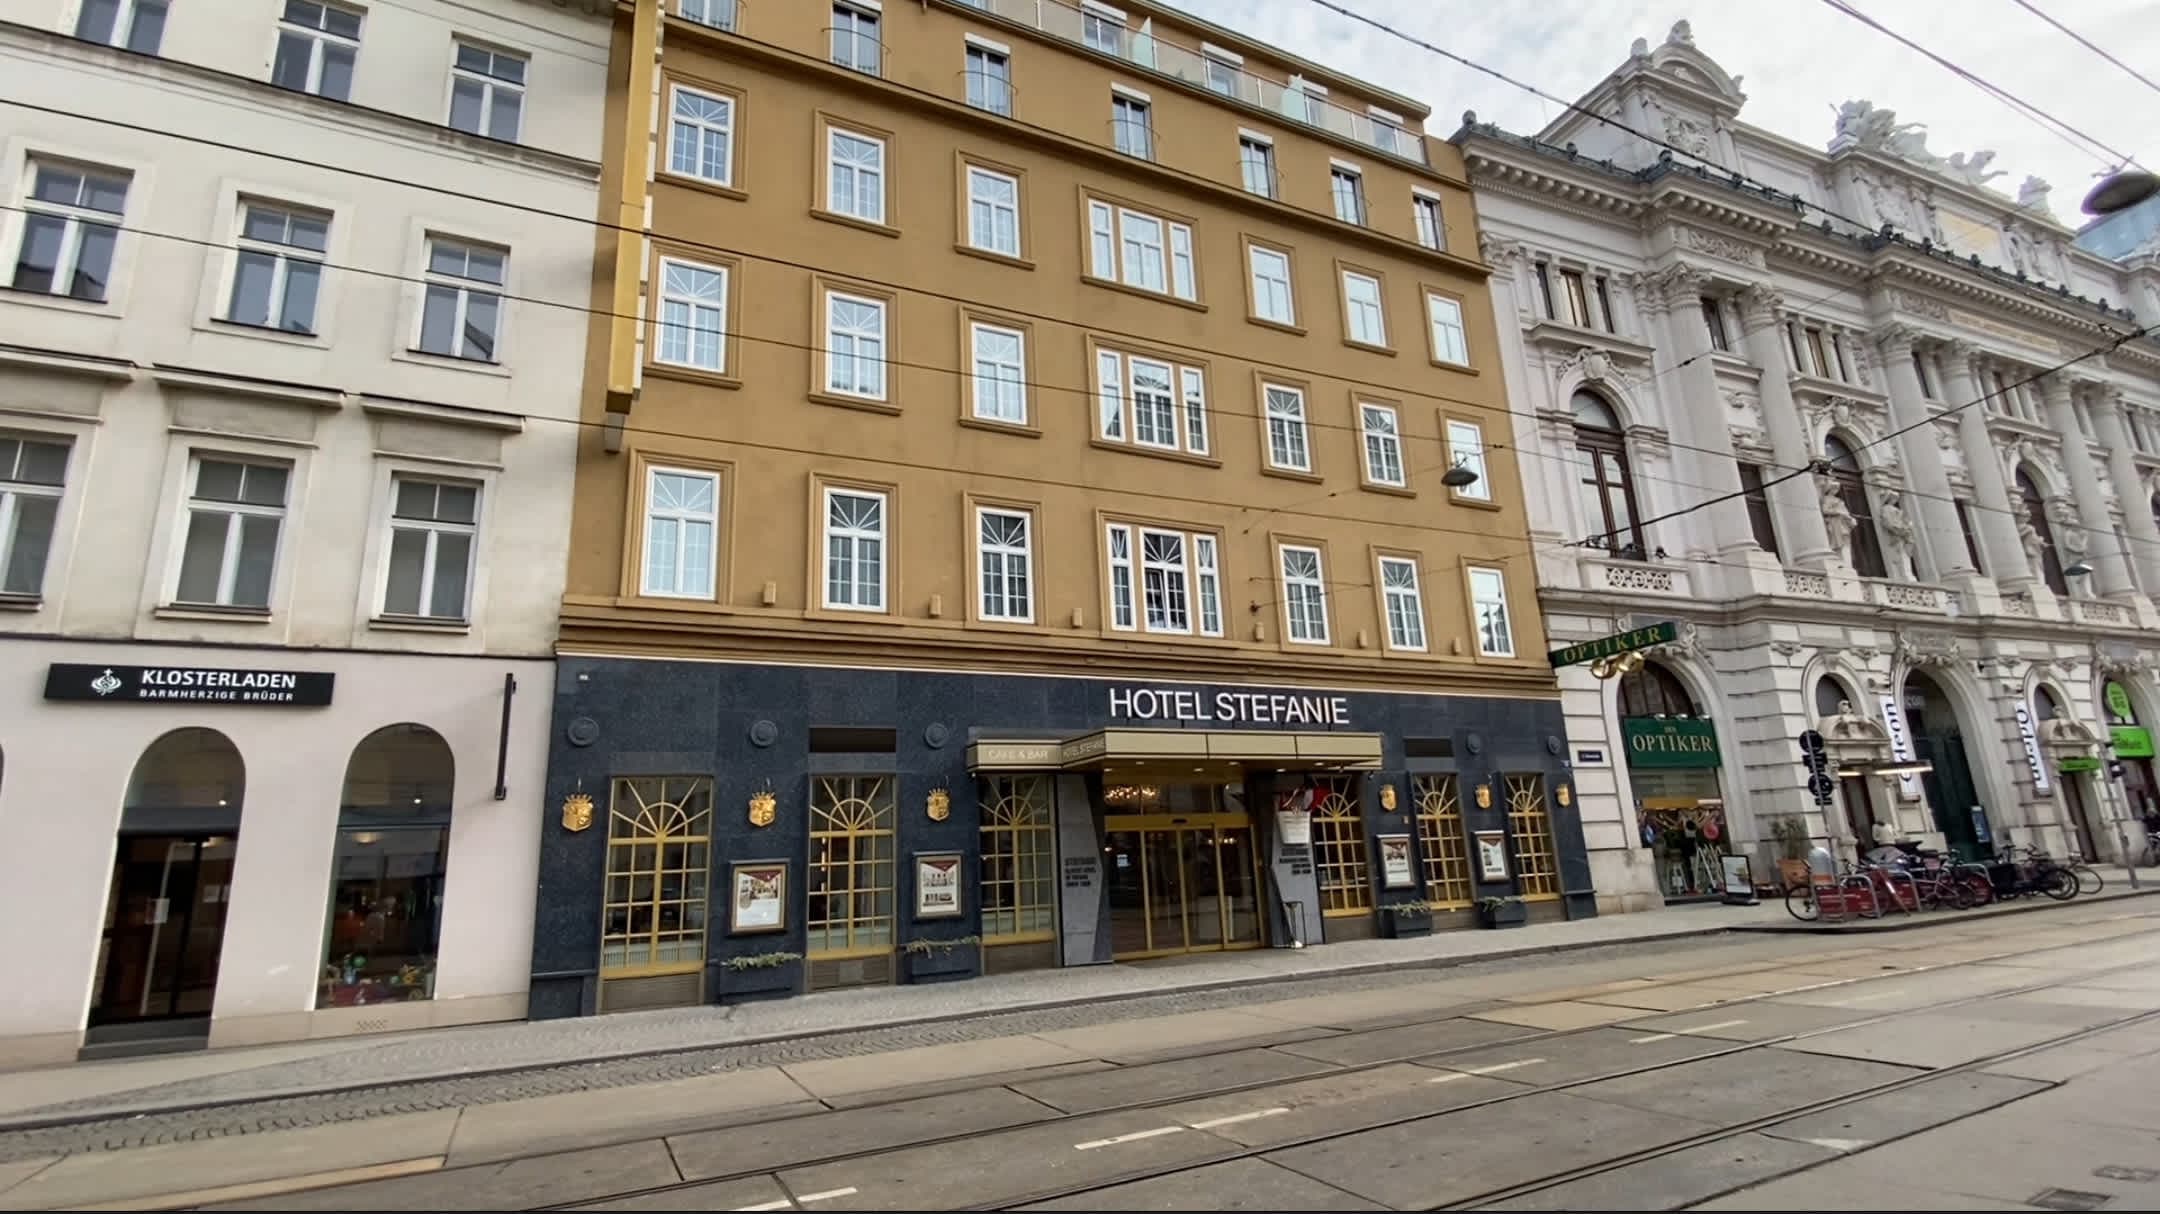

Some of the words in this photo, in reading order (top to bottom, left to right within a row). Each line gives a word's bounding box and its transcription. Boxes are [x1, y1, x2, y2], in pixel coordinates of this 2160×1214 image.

[1563, 626, 1661, 663] OPTIKER
[142, 670, 296, 689] KLOSTERLADEN
[139, 688, 237, 700] BARMHERZIGE
[243, 690, 294, 701] BRÜDER
[1109, 688, 1213, 720] HOTEL
[1215, 692, 1350, 725] STEFANIE
[1632, 734, 1713, 752] OPTIKER
[2016, 709, 2042, 781] Odeon
